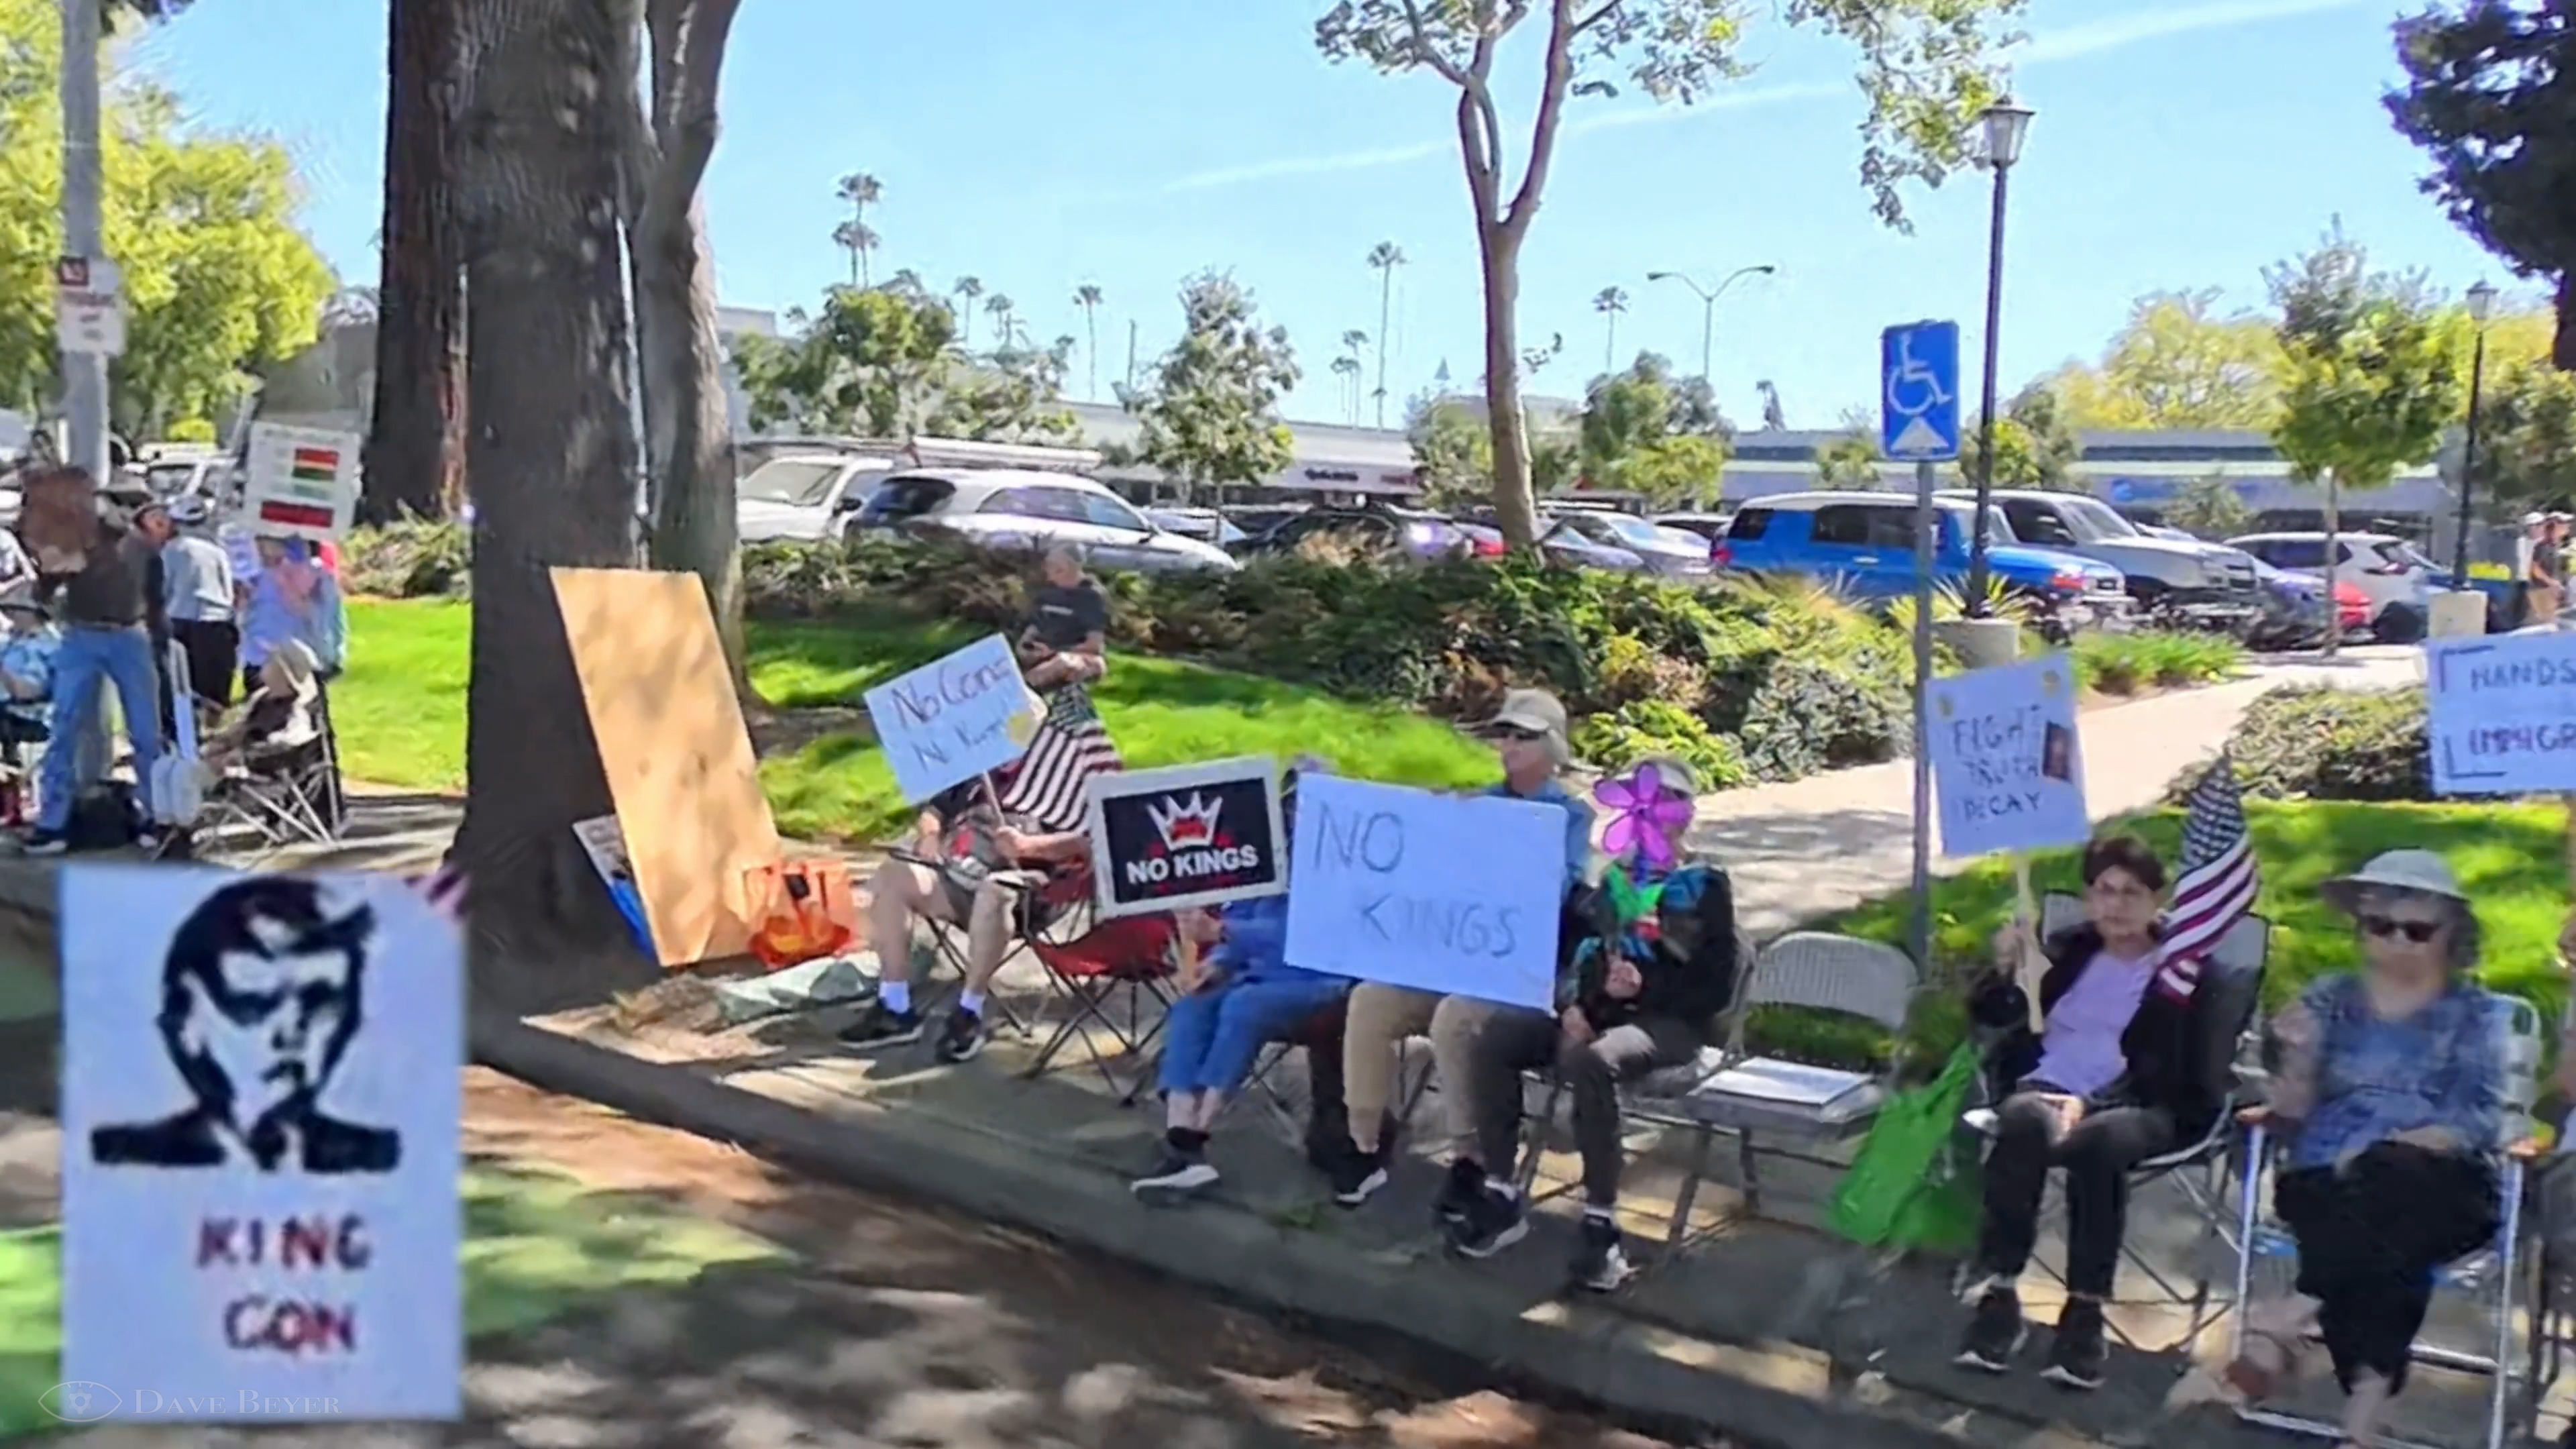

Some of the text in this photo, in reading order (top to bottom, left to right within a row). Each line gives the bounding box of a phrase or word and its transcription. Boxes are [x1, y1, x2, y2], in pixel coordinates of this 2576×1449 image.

[1126, 844, 1259, 885] NO KINGS
[1313, 801, 1404, 873] NO
[1360, 892, 1521, 959] KINGS
[223, 1294, 358, 1356] CON
